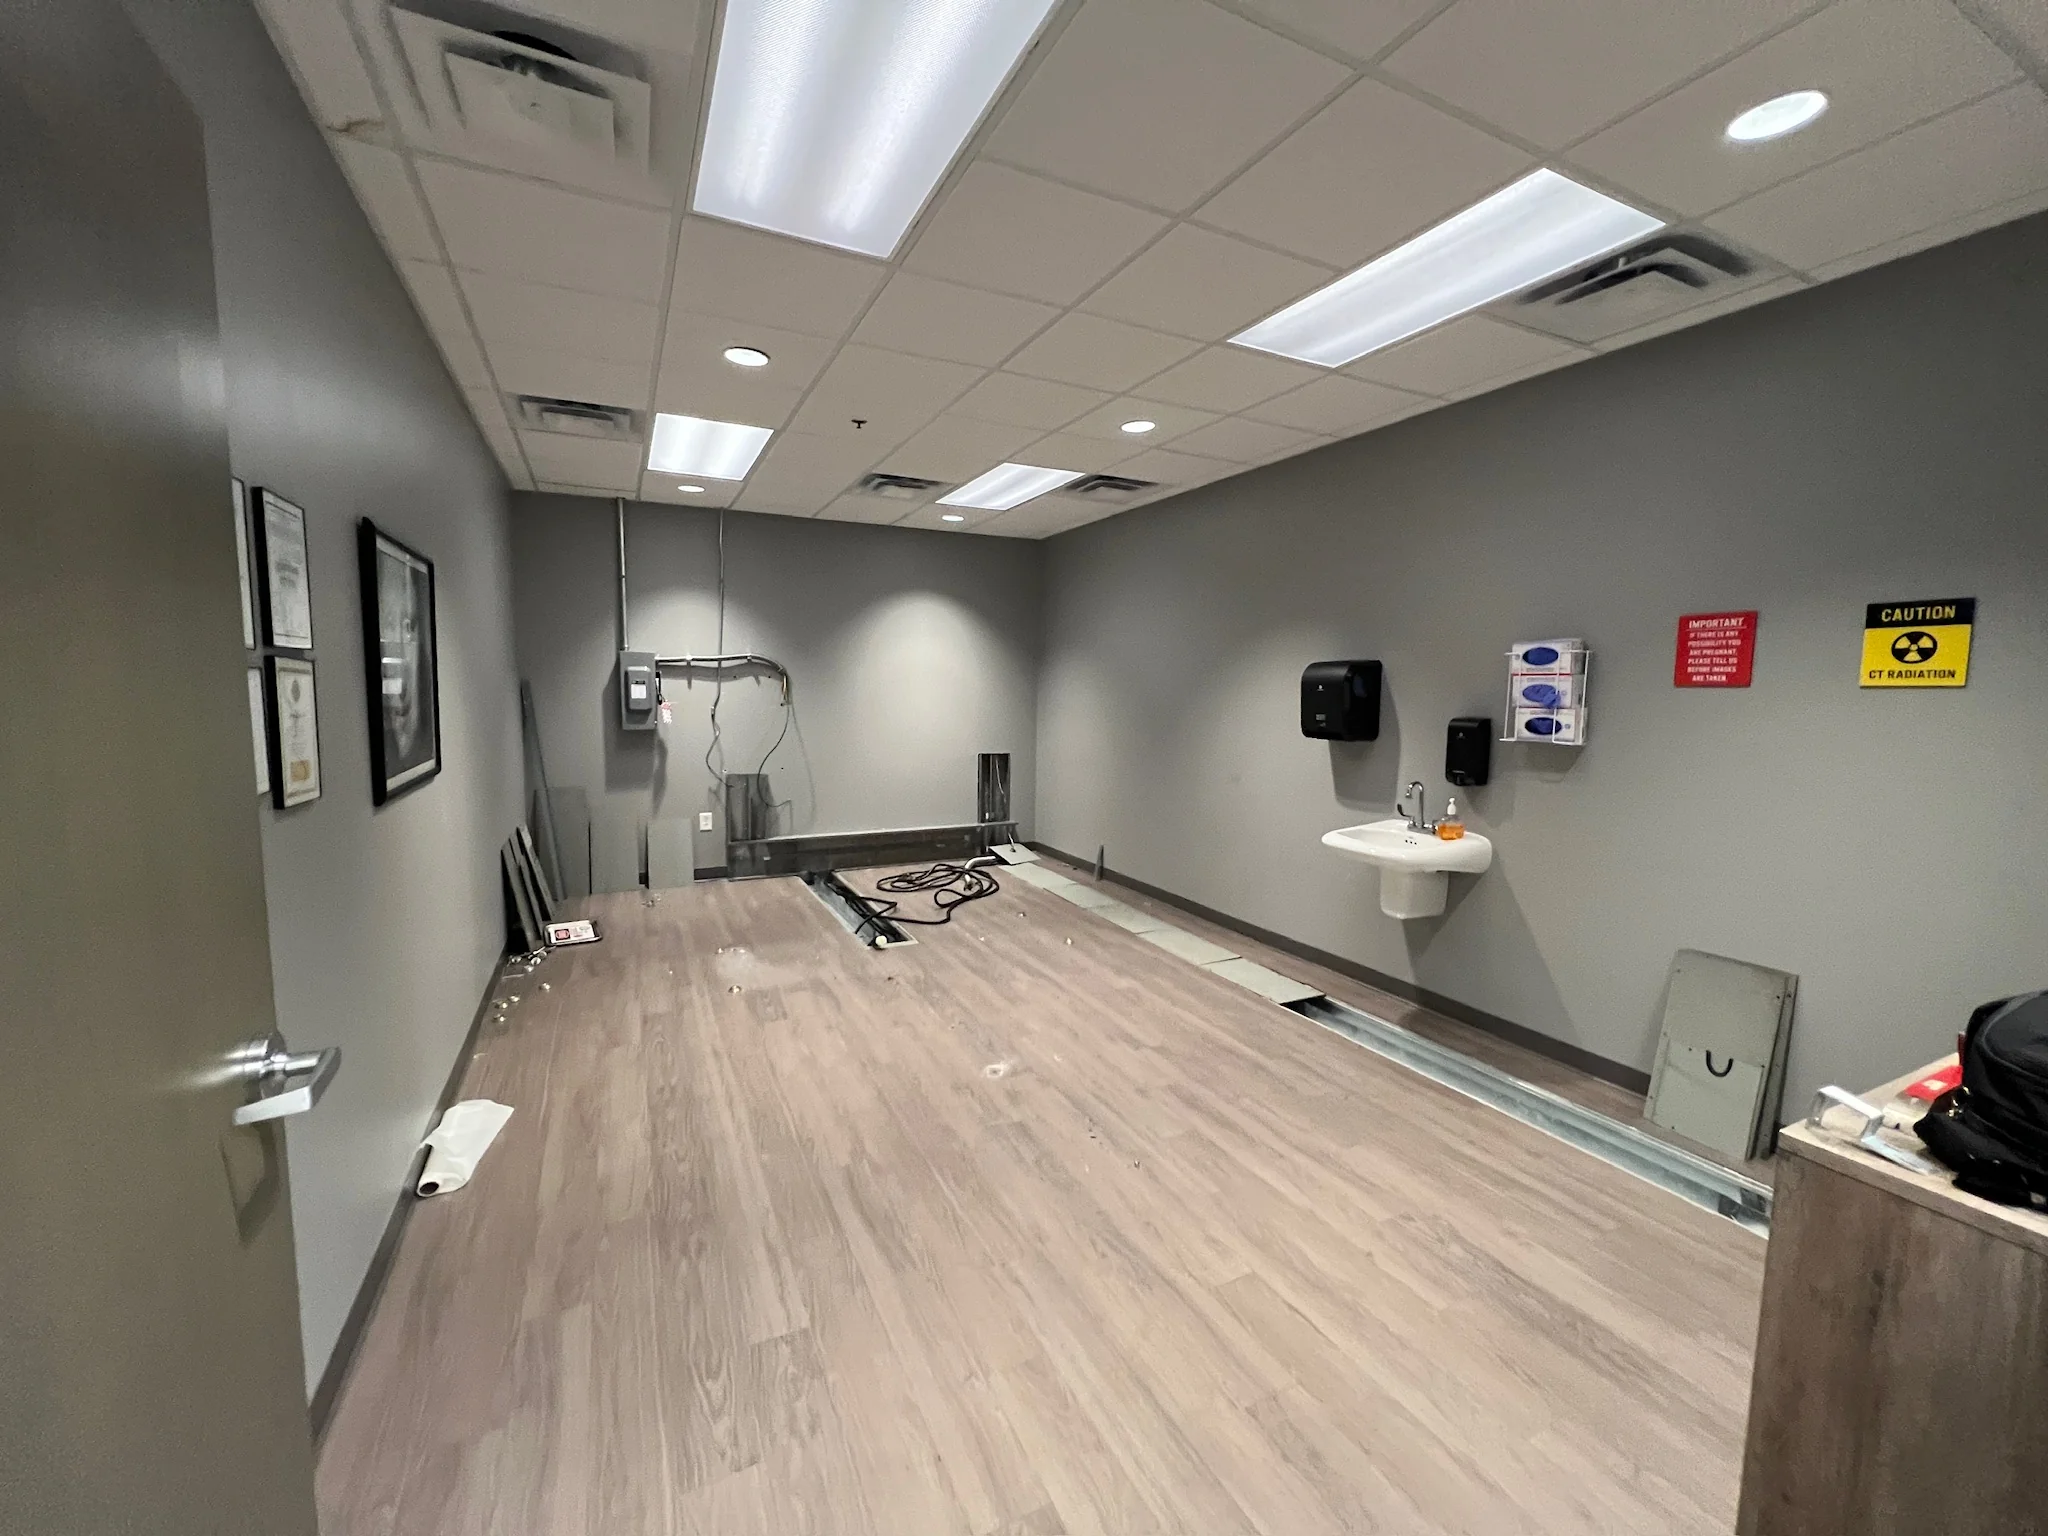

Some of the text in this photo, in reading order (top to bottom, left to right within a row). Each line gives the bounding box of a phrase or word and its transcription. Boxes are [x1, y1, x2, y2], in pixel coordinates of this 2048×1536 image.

[1881, 605, 1956, 622] CAUTION
[1688, 617, 1744, 628] IMPORTANT
[1869, 669, 1956, 679] CT RADIATION
